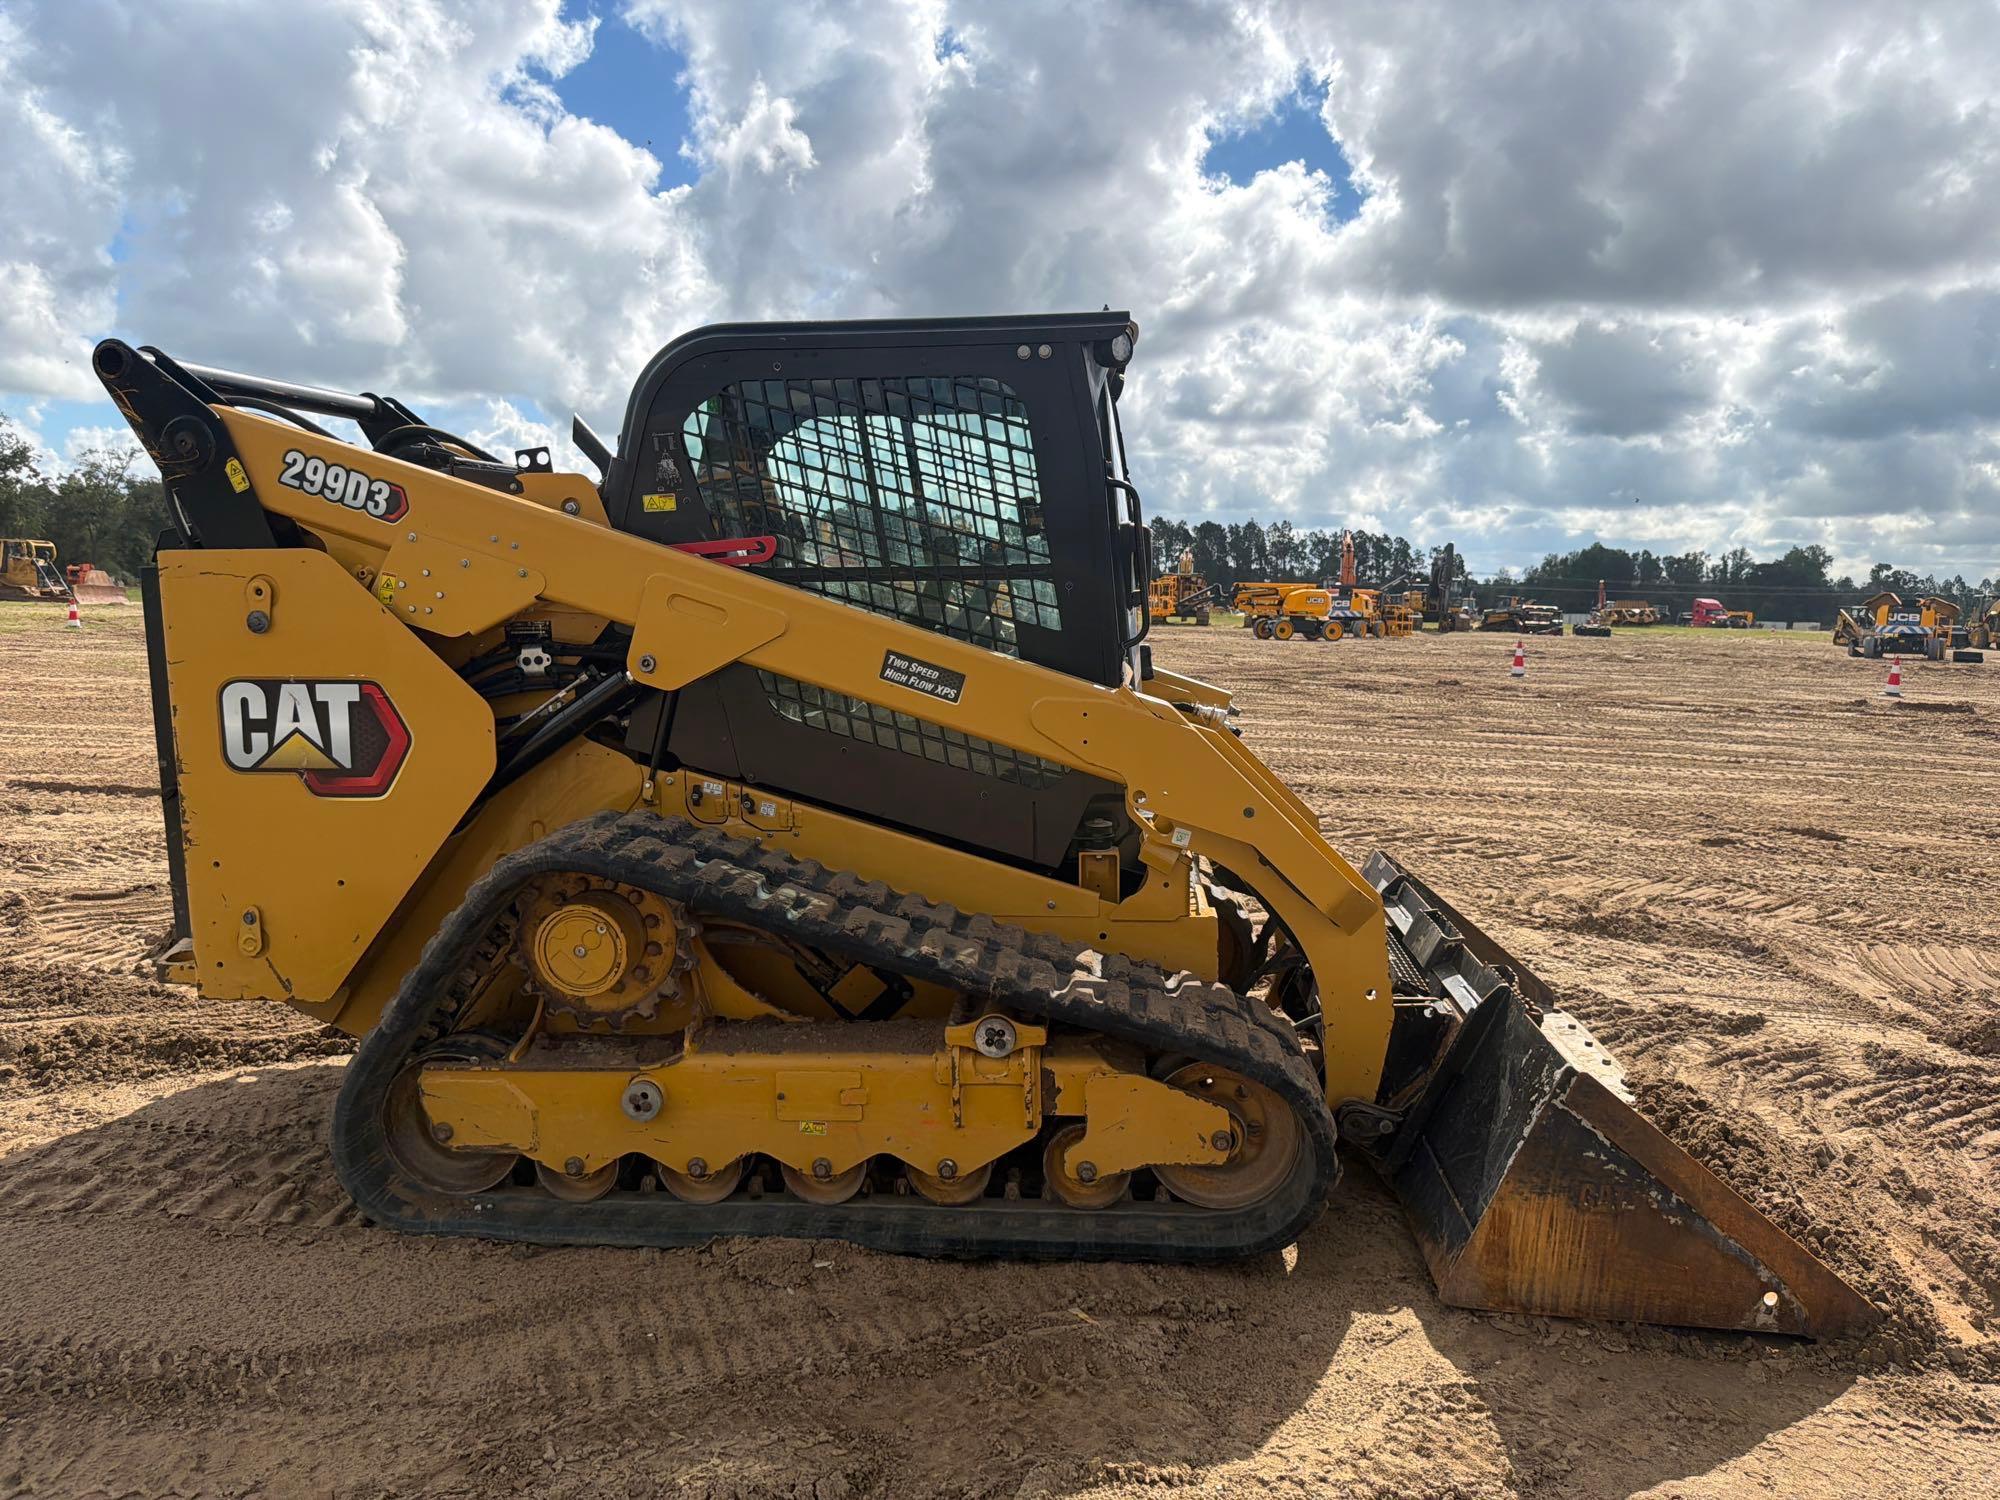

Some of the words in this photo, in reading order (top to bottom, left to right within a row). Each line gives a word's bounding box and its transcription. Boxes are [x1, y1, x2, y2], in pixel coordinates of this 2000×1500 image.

[280, 450, 391, 516] 299D3
[1888, 613, 1920, 622] JCB
[935, 684, 957, 699] XPS
[222, 682, 360, 769] CAT
